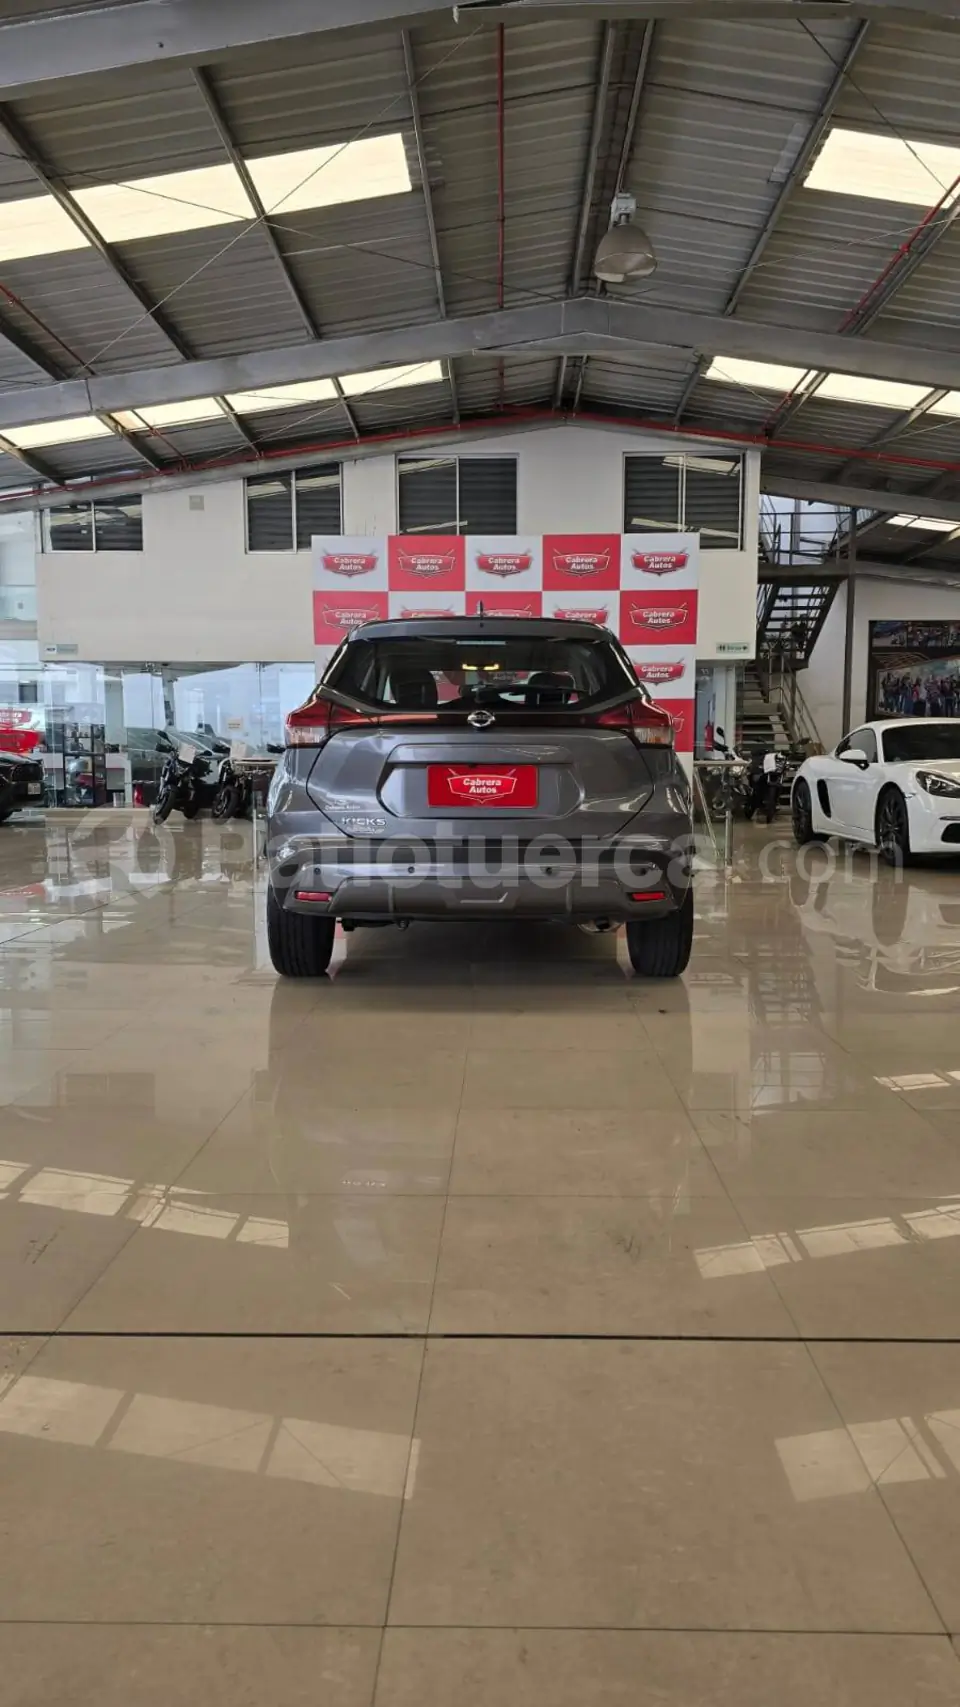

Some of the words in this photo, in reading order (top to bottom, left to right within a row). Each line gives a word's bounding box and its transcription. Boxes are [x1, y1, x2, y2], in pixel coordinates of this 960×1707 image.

[333, 556, 366, 564] Cabrera
[334, 611, 367, 619] Cabrera
[565, 611, 597, 619] Cabrera
[463, 778, 502, 786] Cabrera
[469, 786, 497, 794] Autos
[341, 817, 387, 826] KICKS
